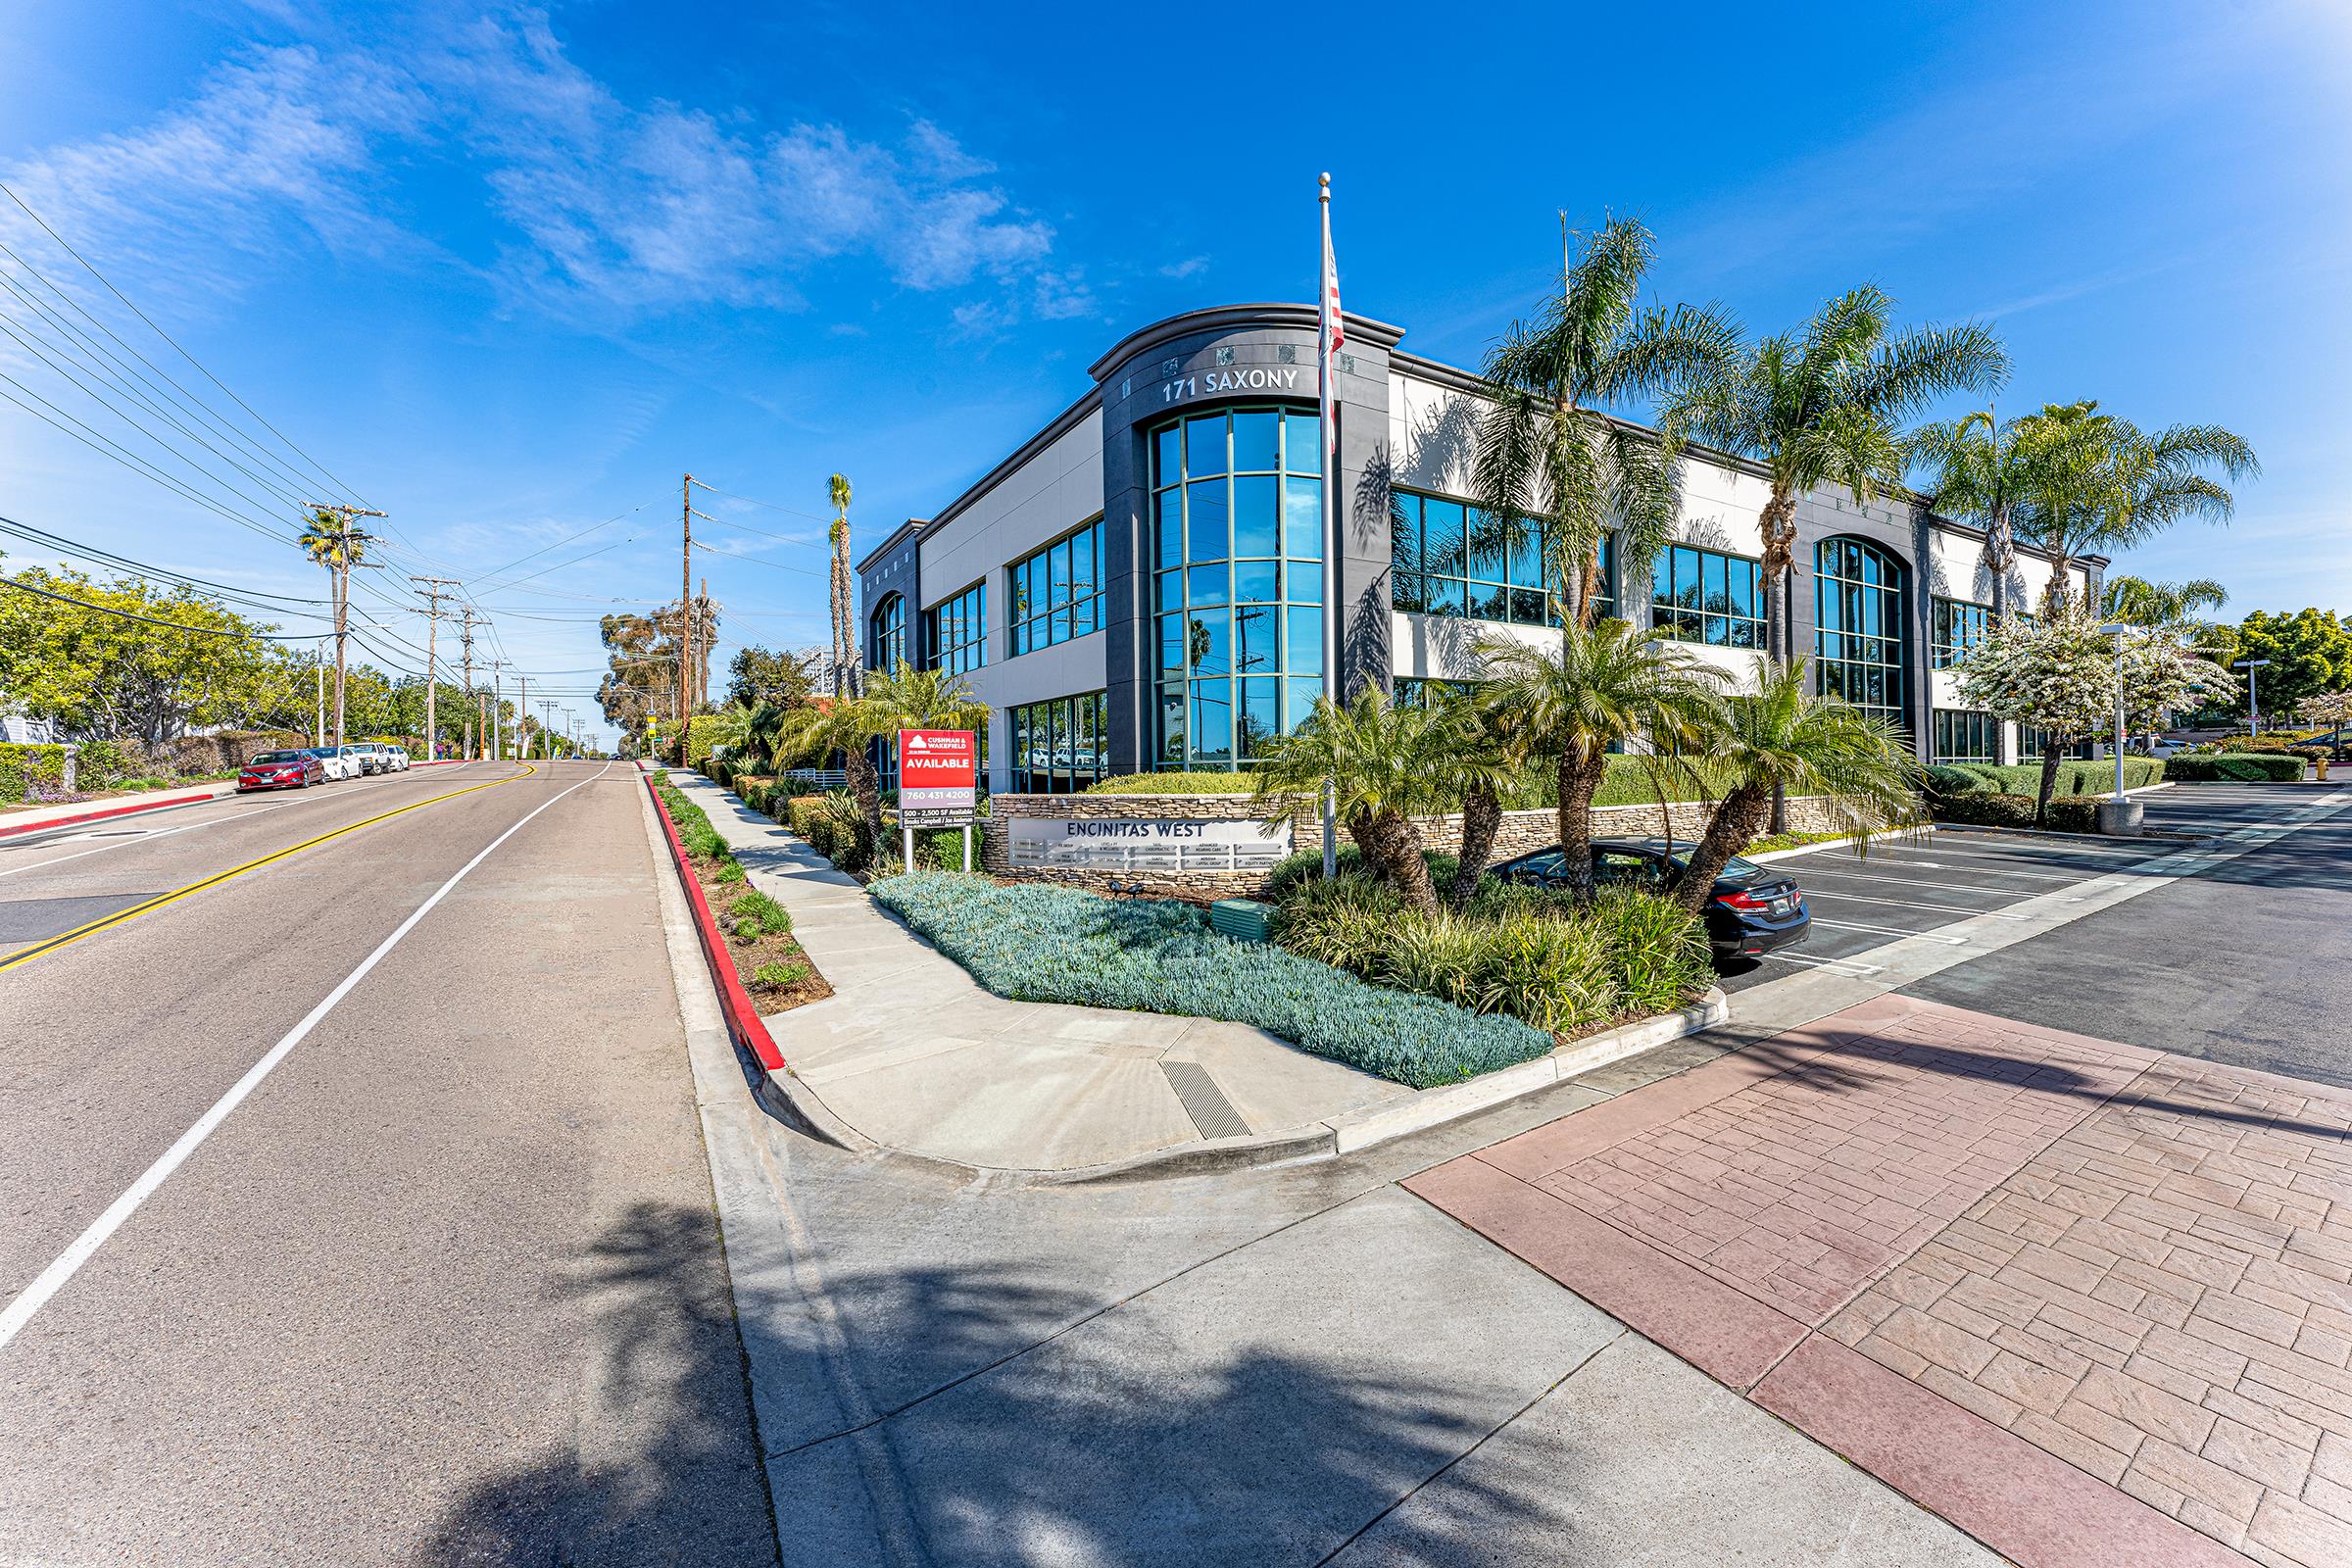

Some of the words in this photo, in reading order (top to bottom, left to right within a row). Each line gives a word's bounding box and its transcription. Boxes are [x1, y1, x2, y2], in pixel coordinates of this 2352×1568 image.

[1163, 376, 1196, 402] 171
[1205, 368, 1298, 394] SAXONY
[906, 759, 969, 768] AVAILABLE
[1067, 822, 1150, 837] ENCINITAS
[1156, 823, 1205, 837] WEST
